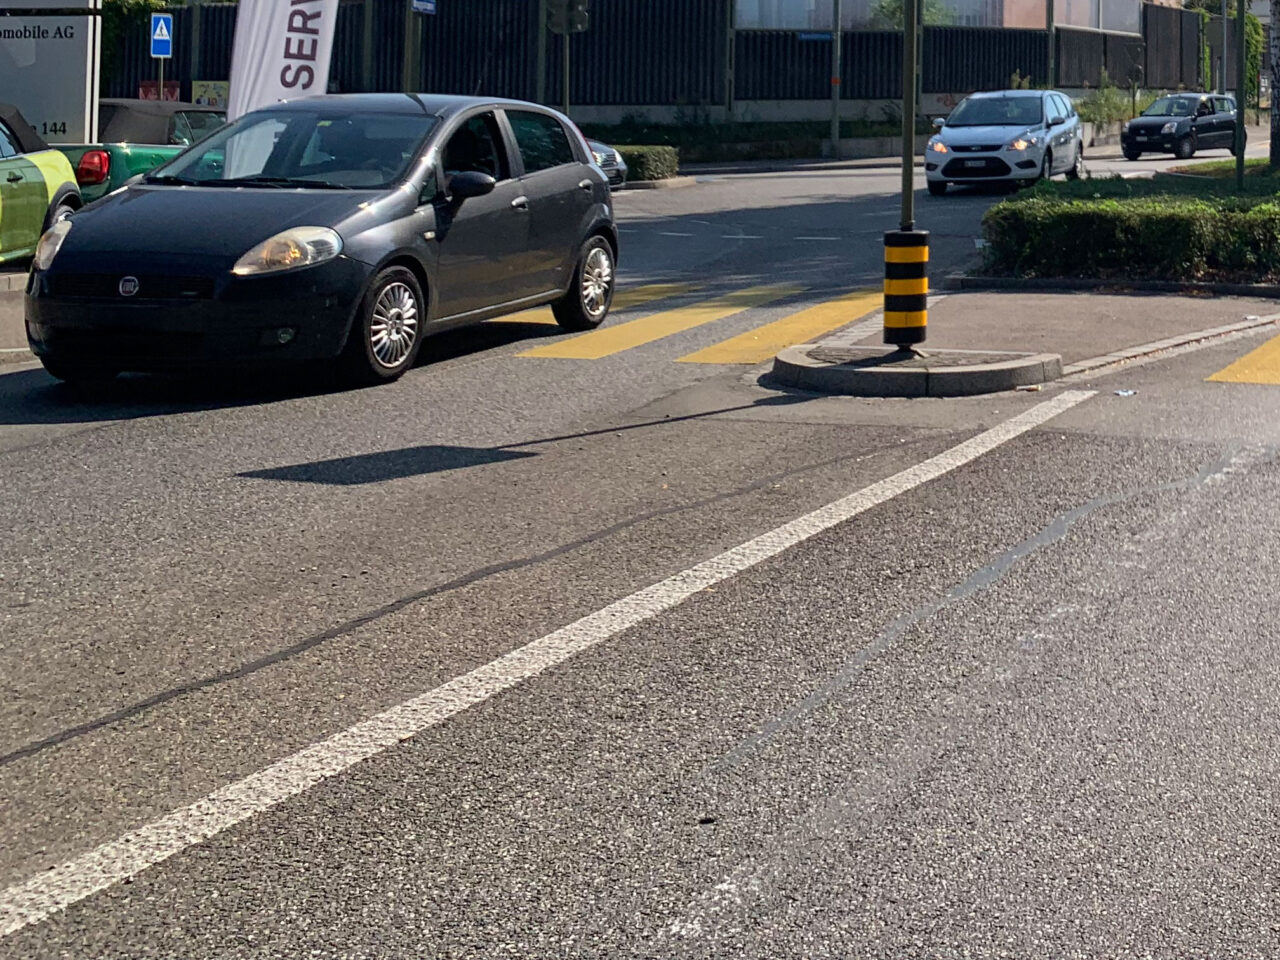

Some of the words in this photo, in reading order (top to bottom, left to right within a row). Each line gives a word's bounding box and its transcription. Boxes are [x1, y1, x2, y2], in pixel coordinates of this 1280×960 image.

[0, 25, 49, 39] mobile
[53, 25, 75, 39] AG
[42, 122, 67, 135] 144
